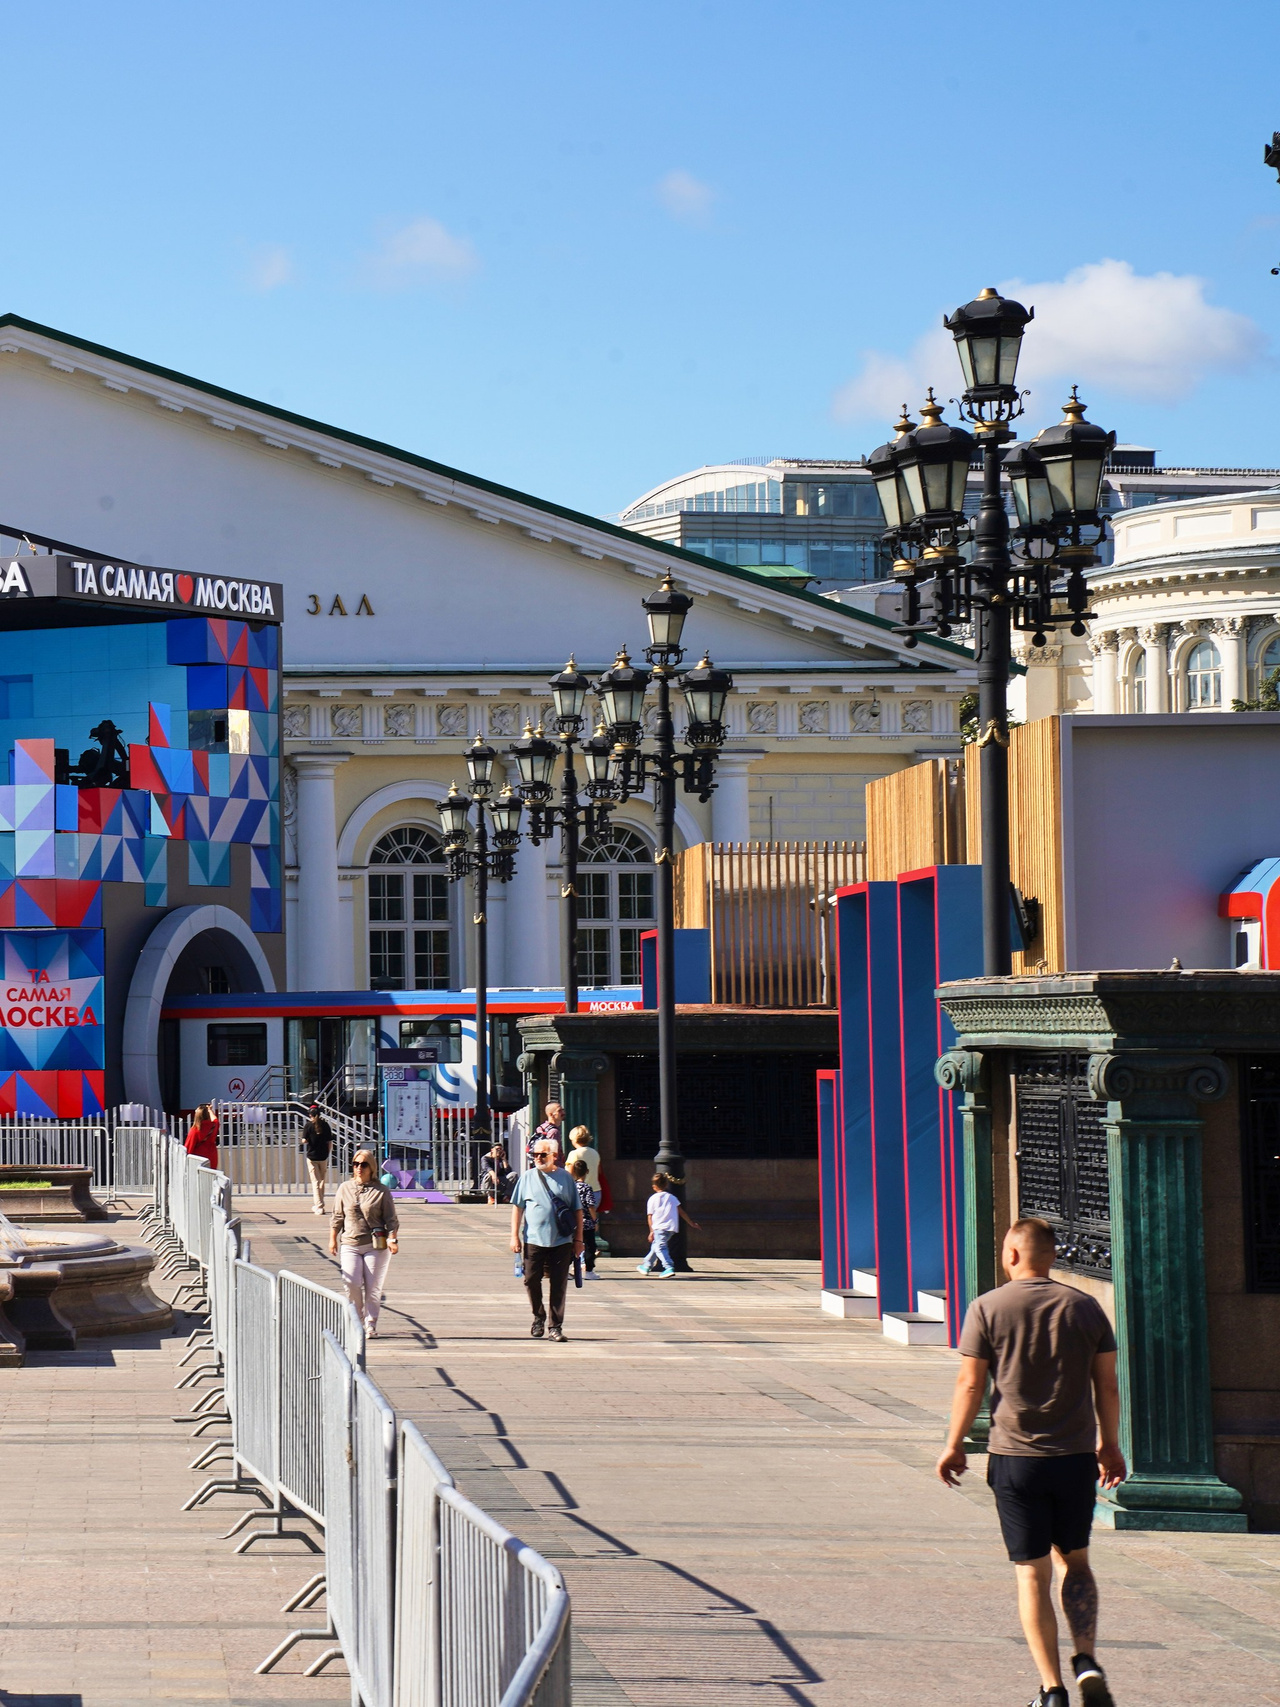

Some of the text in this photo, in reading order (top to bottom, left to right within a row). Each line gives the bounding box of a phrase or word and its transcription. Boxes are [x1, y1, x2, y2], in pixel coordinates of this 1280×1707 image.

[73, 561, 275, 616] ТА САМАЯ МОСКВА
[307, 593, 375, 616] ЗАЛ
[28, 969, 50, 983] ТА
[6, 987, 71, 1002] САМАЯ
[589, 1001, 636, 1011] МОСКВА
[383, 1071, 404, 1080] 2030
